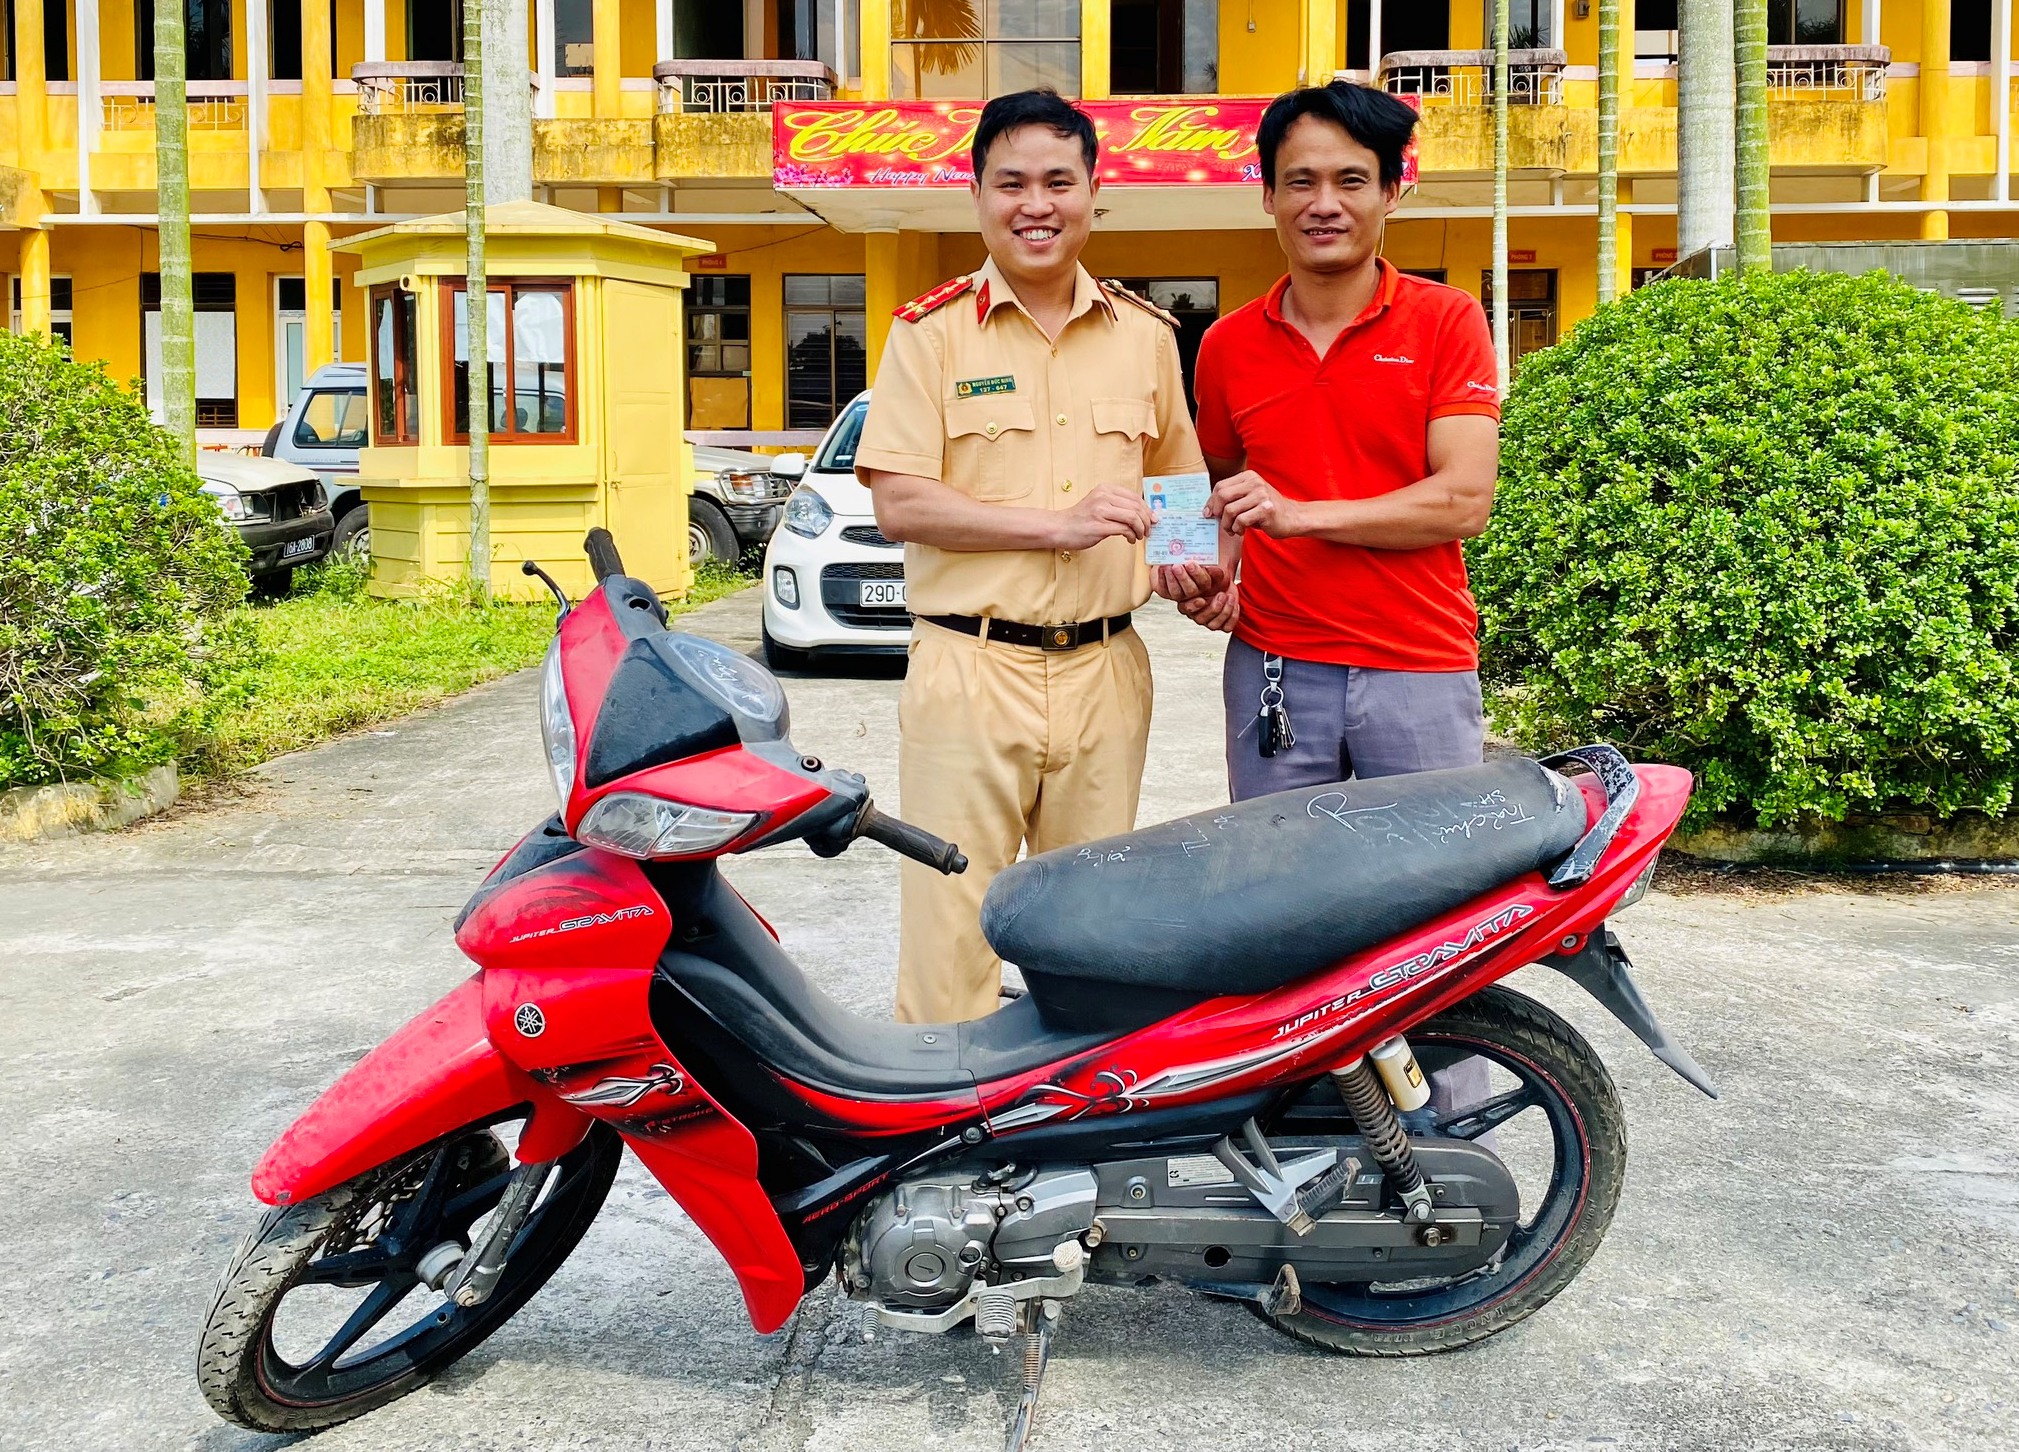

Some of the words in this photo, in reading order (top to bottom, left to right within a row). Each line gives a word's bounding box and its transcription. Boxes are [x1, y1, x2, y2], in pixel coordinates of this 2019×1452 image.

[870, 167, 927, 184] Happy
[509, 927, 555, 944] JUPITER
[559, 903, 655, 932] GRAVITA
[1271, 989, 1362, 1040] JUPITER
[1368, 903, 1535, 990] GRAVITA
